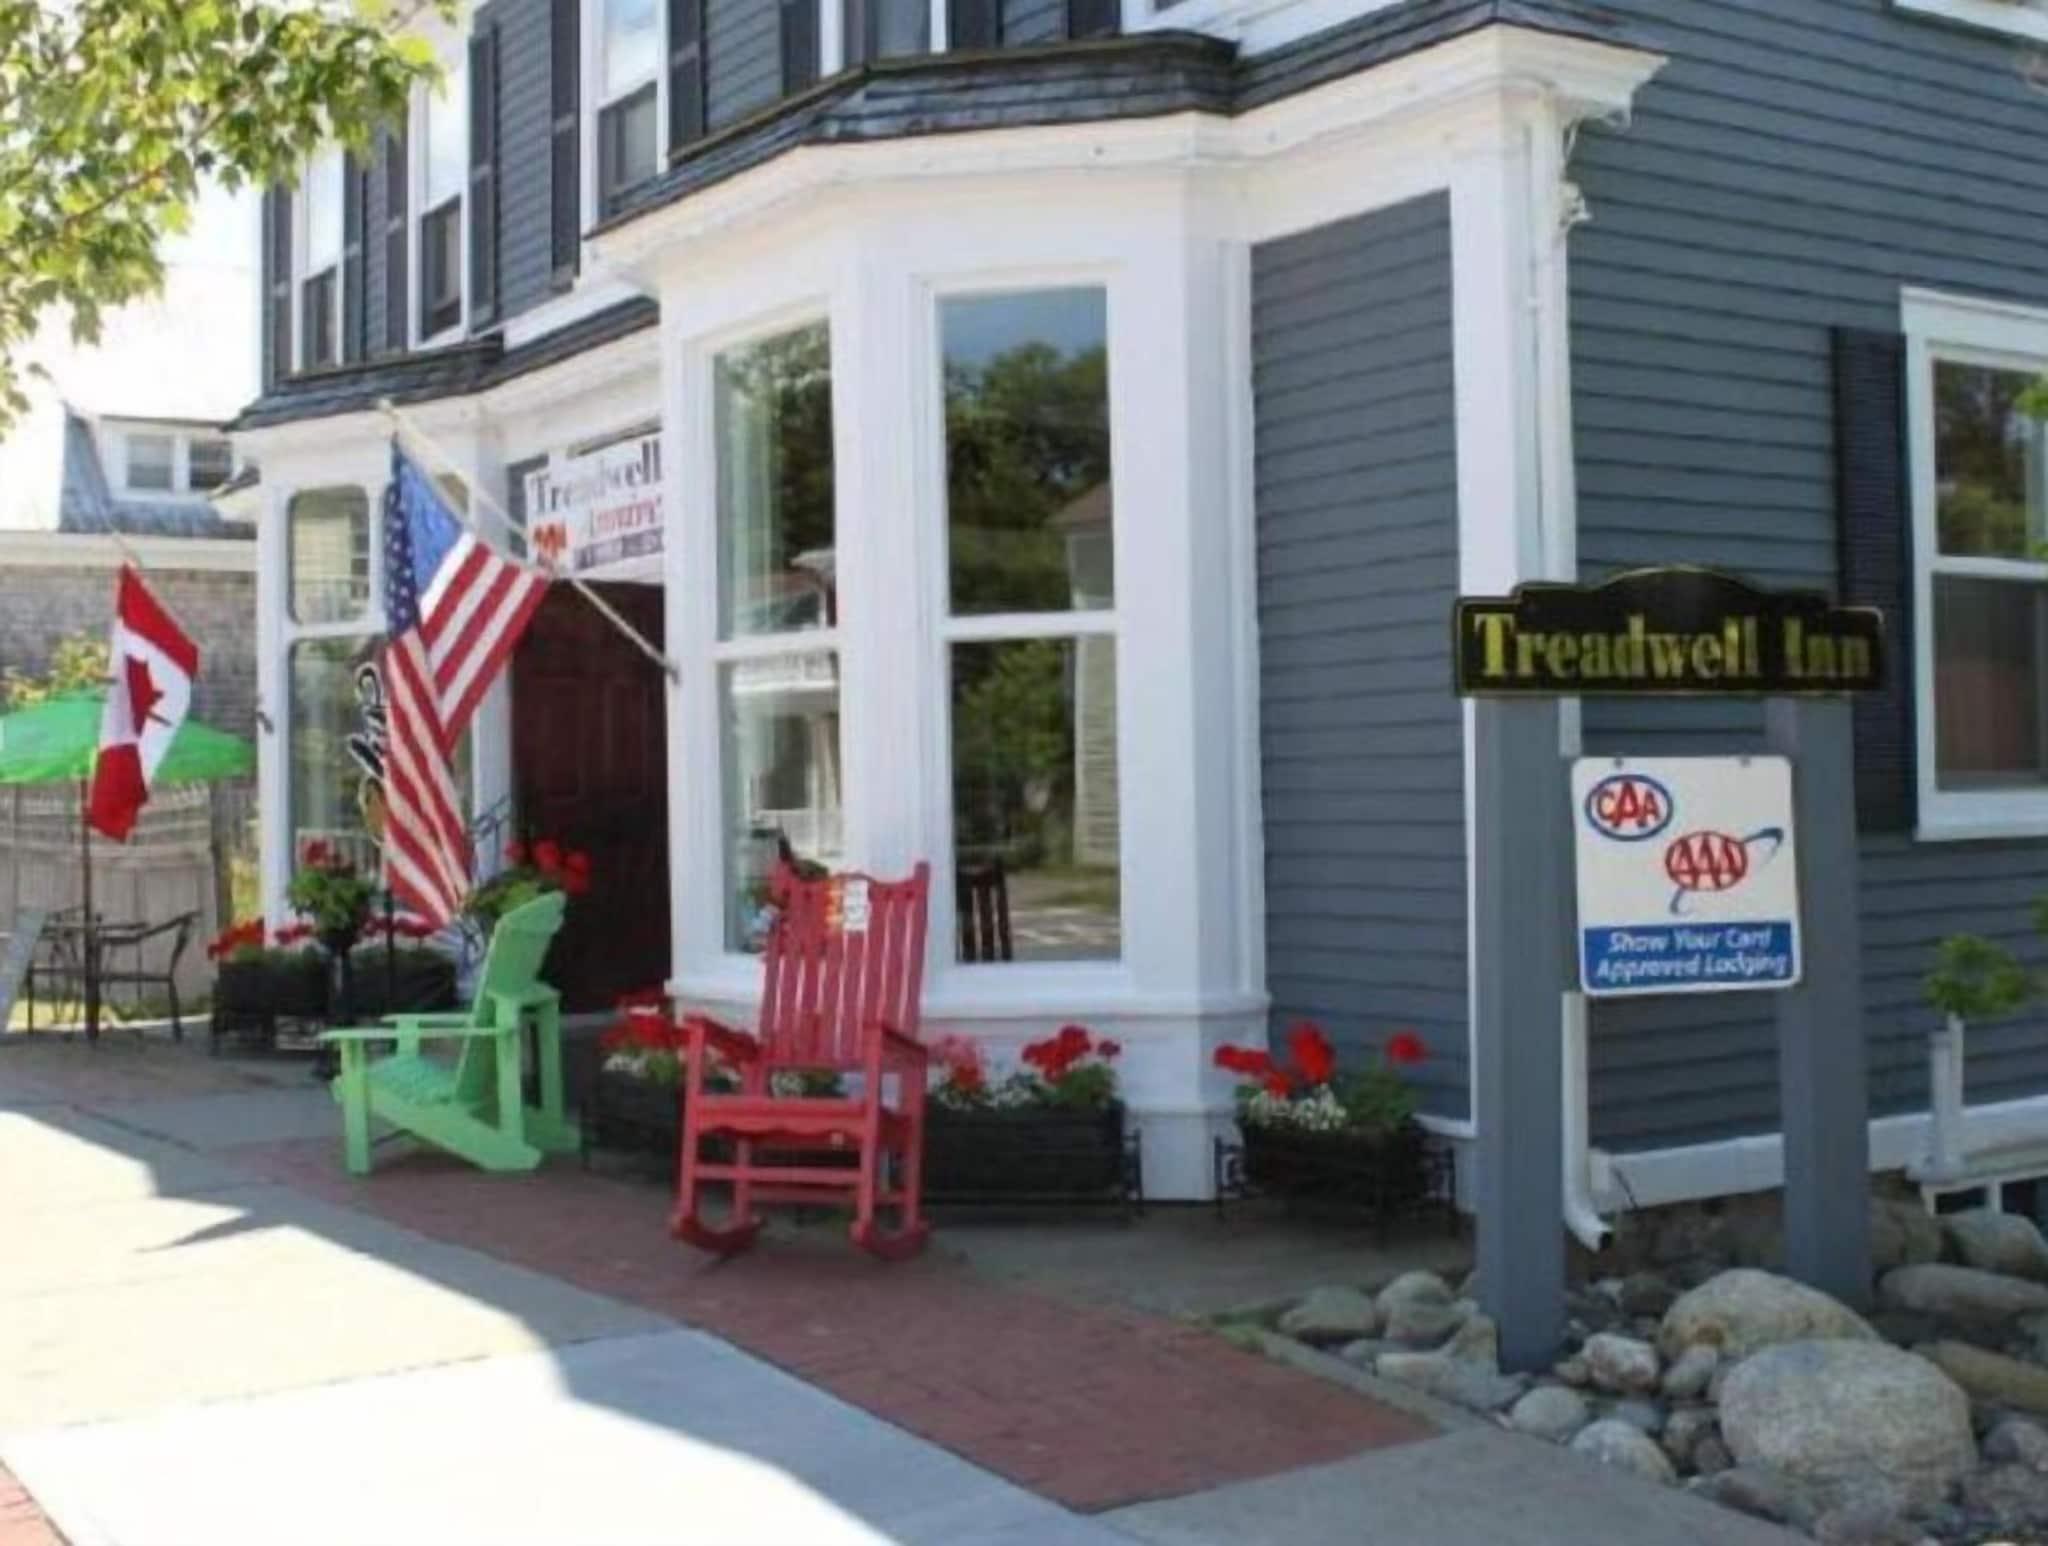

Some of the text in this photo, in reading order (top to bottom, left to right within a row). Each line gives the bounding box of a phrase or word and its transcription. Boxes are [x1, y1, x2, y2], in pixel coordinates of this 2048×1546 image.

[1474, 612, 1871, 679] Treadwell Inn
[1595, 780, 1661, 829] CAA
[1667, 832, 1746, 889] AAA
[1608, 927, 1772, 954] Show Your Card
[1597, 952, 1787, 983] Approved Lodging
